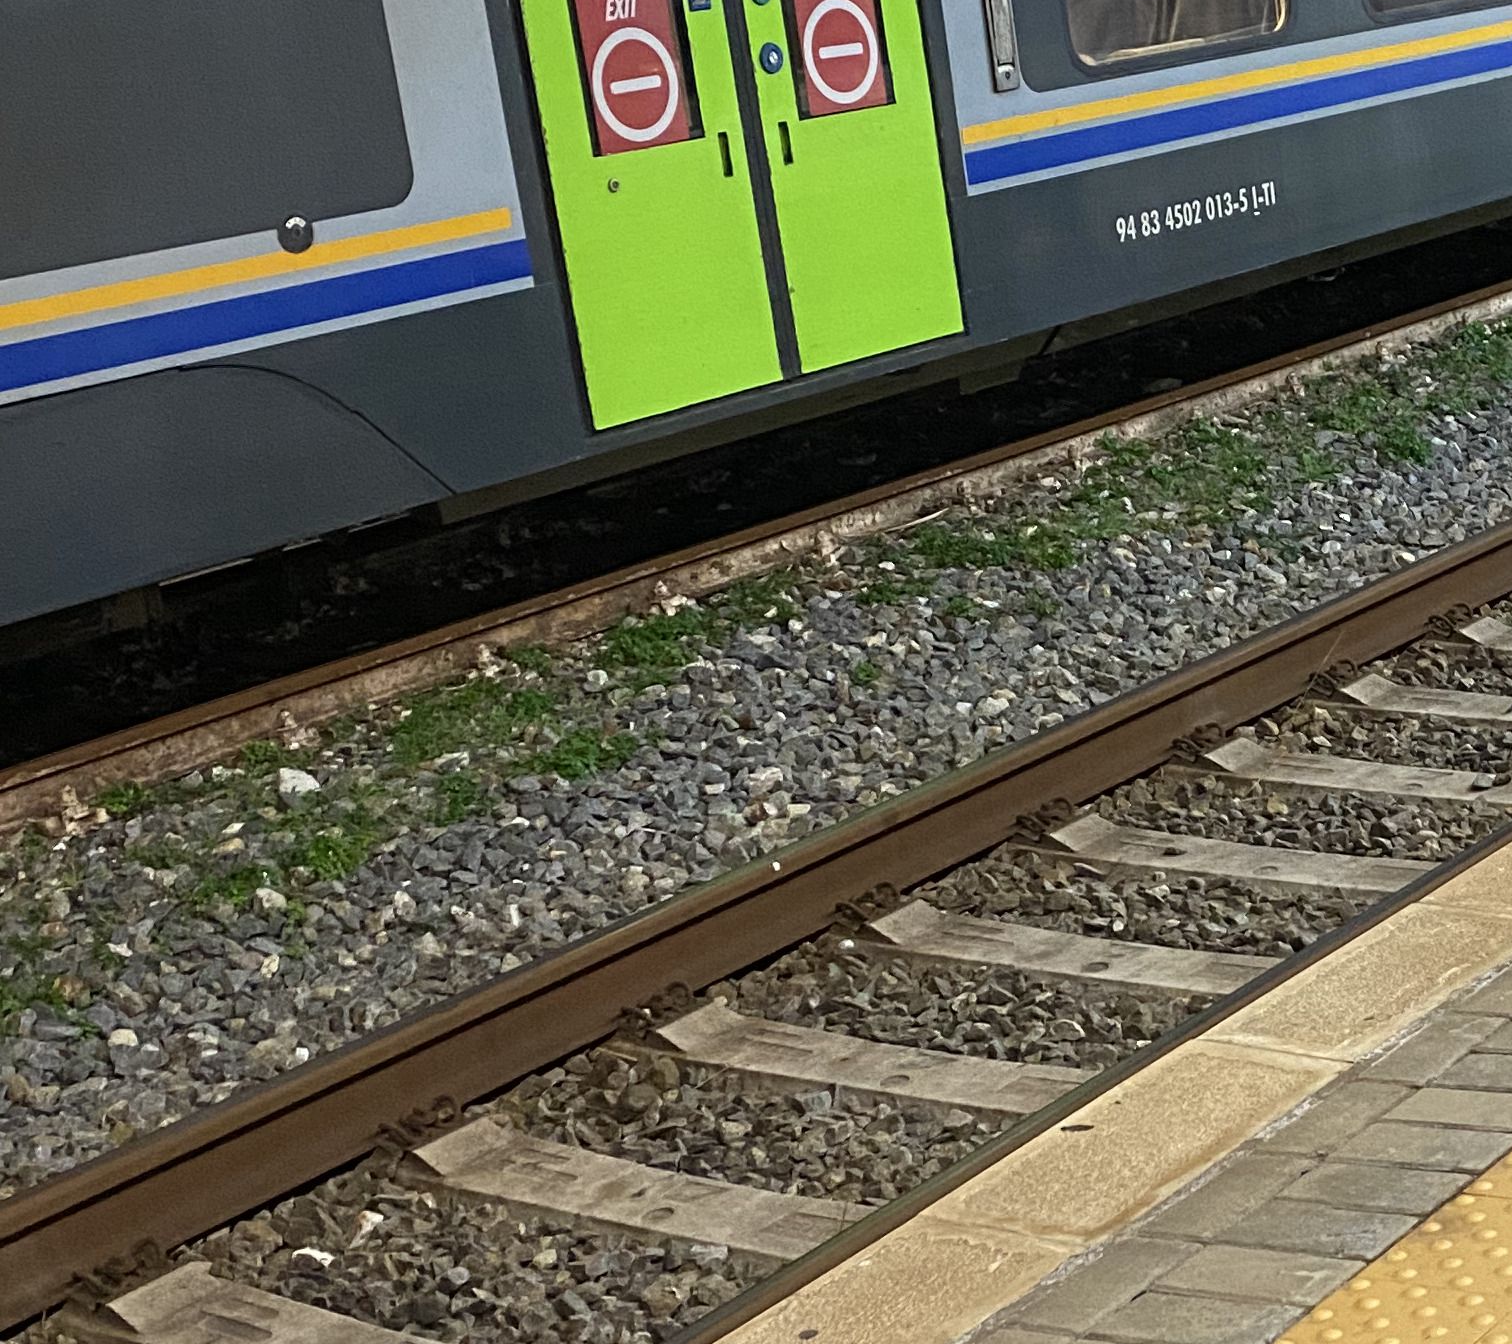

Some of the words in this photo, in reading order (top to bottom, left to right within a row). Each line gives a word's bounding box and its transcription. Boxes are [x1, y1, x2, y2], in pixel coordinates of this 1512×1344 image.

[1116, 215, 1136, 242] 94
[1140, 209, 1161, 237] 83
[1165, 199, 1202, 231] 4502
[1205, 188, 1248, 220] 013-5
